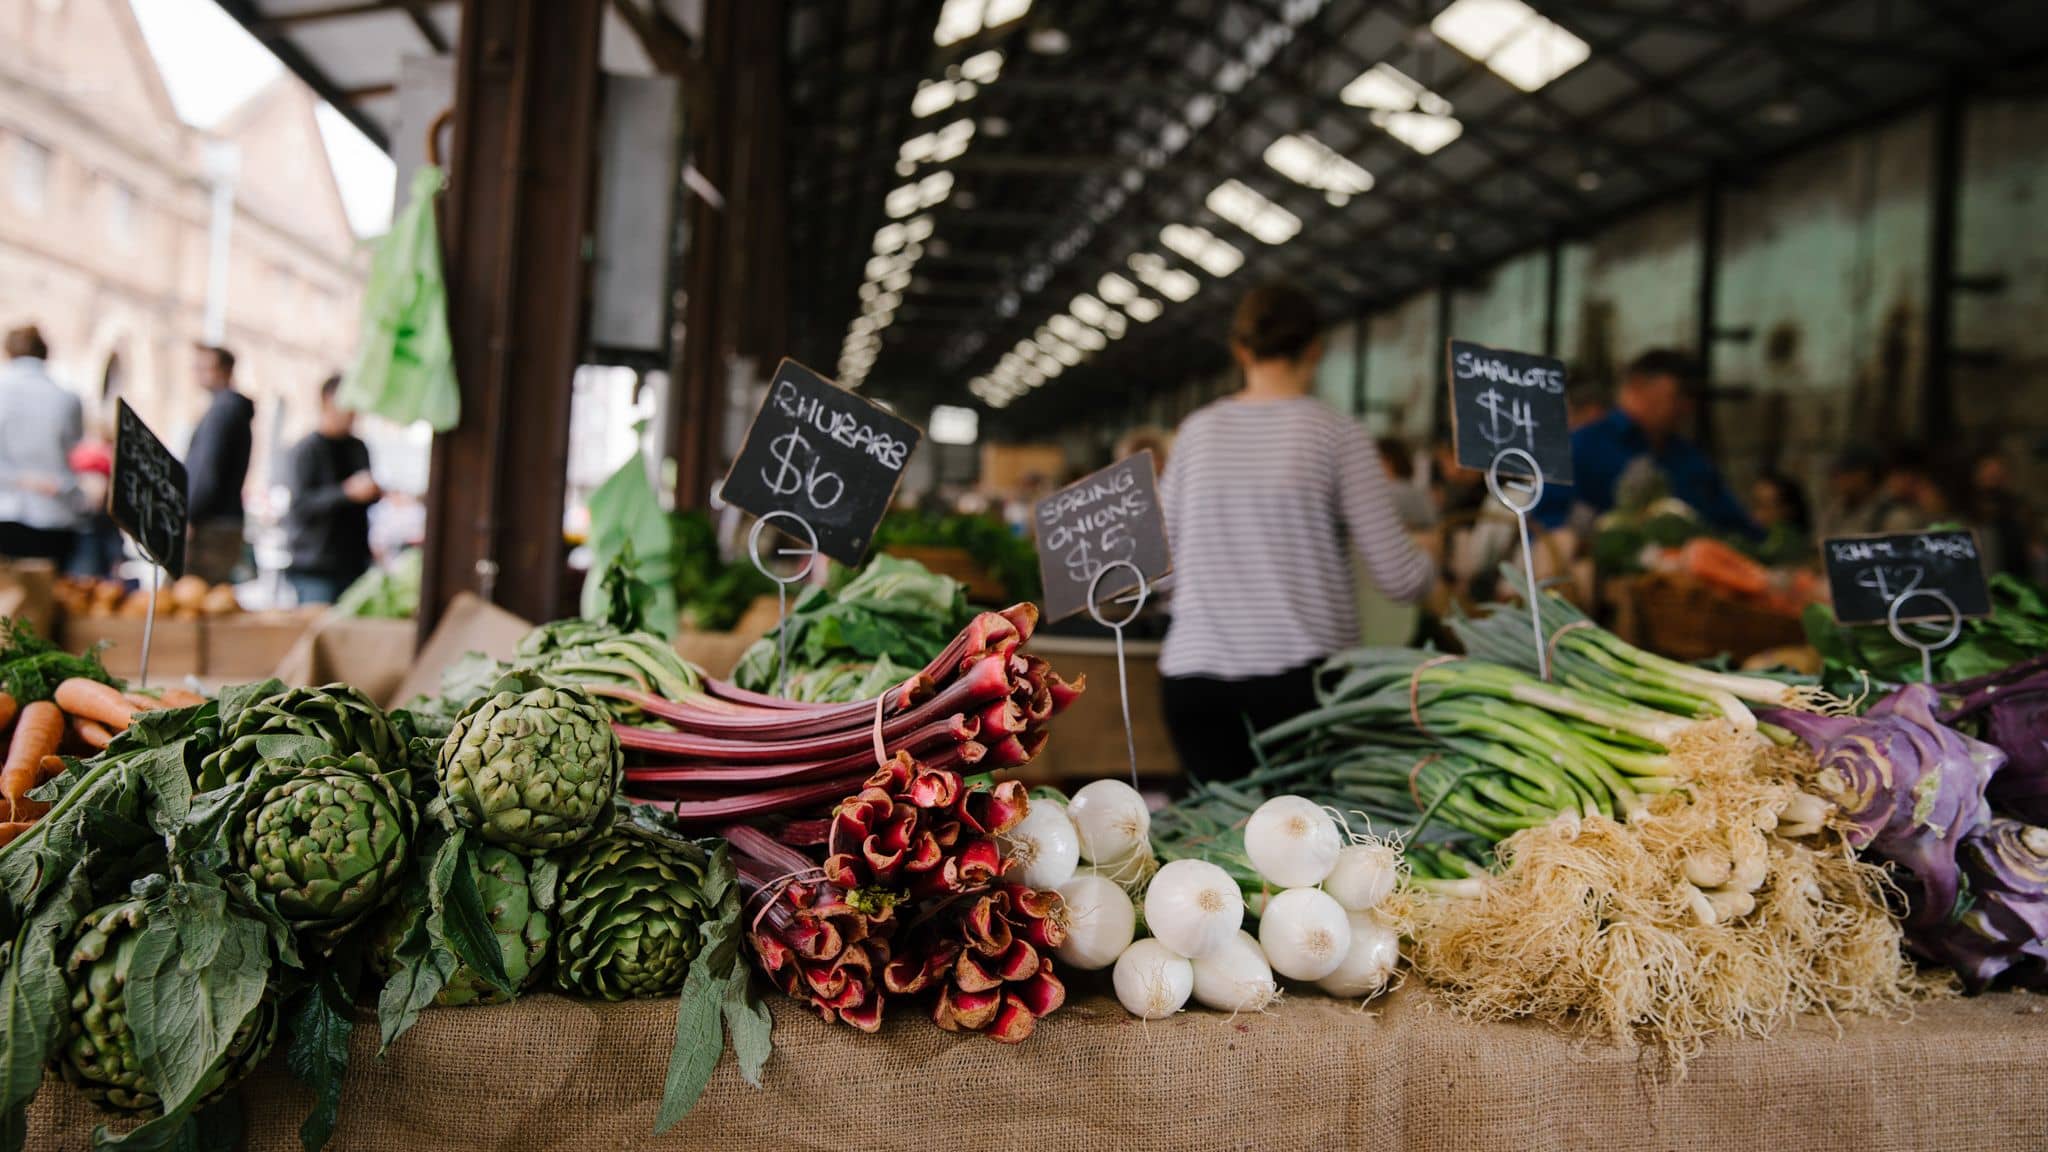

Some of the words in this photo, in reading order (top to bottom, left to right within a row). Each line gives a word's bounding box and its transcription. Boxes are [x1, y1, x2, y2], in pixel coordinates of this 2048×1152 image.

[1456, 352, 1564, 393] SHALLOTS
[774, 381, 907, 470] RHUBARB
[1475, 387, 1539, 452] $4
[761, 427, 844, 509] $6
[1041, 467, 1134, 525] SPRING
[1048, 489, 1148, 550] ONIONS
